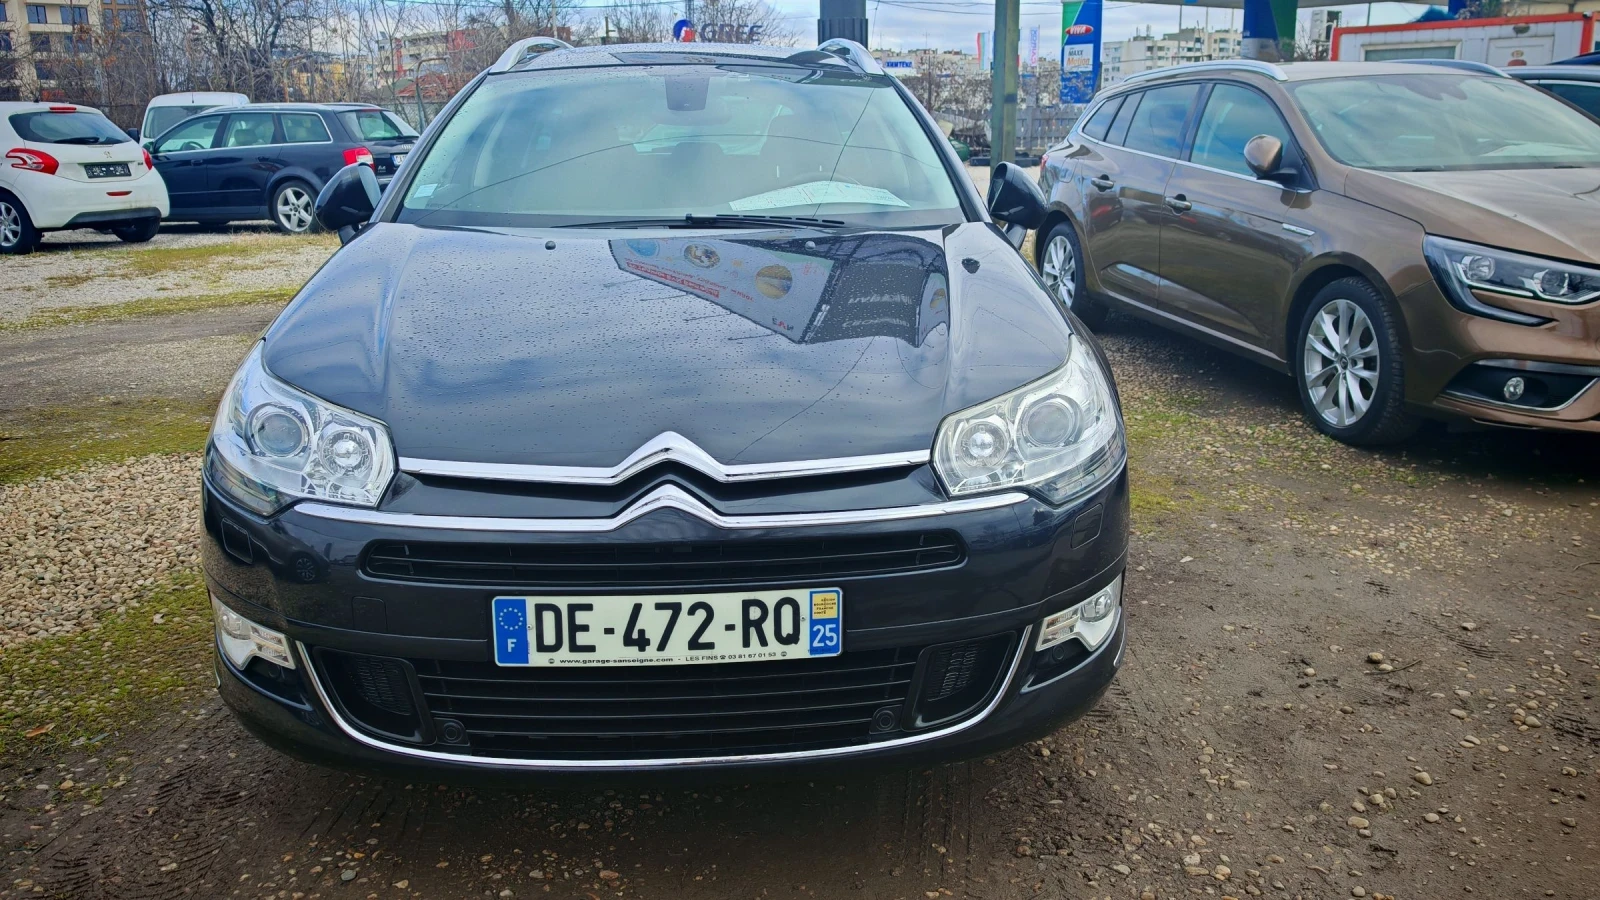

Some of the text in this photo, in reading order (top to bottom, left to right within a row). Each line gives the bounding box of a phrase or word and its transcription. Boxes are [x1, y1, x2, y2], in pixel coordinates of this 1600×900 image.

[701, 23, 762, 43] GREE
[1070, 26, 1086, 34] VIVA
[534, 597, 800, 653] DE-472-RQ
[812, 624, 838, 647] 25
[507, 639, 517, 653] F
